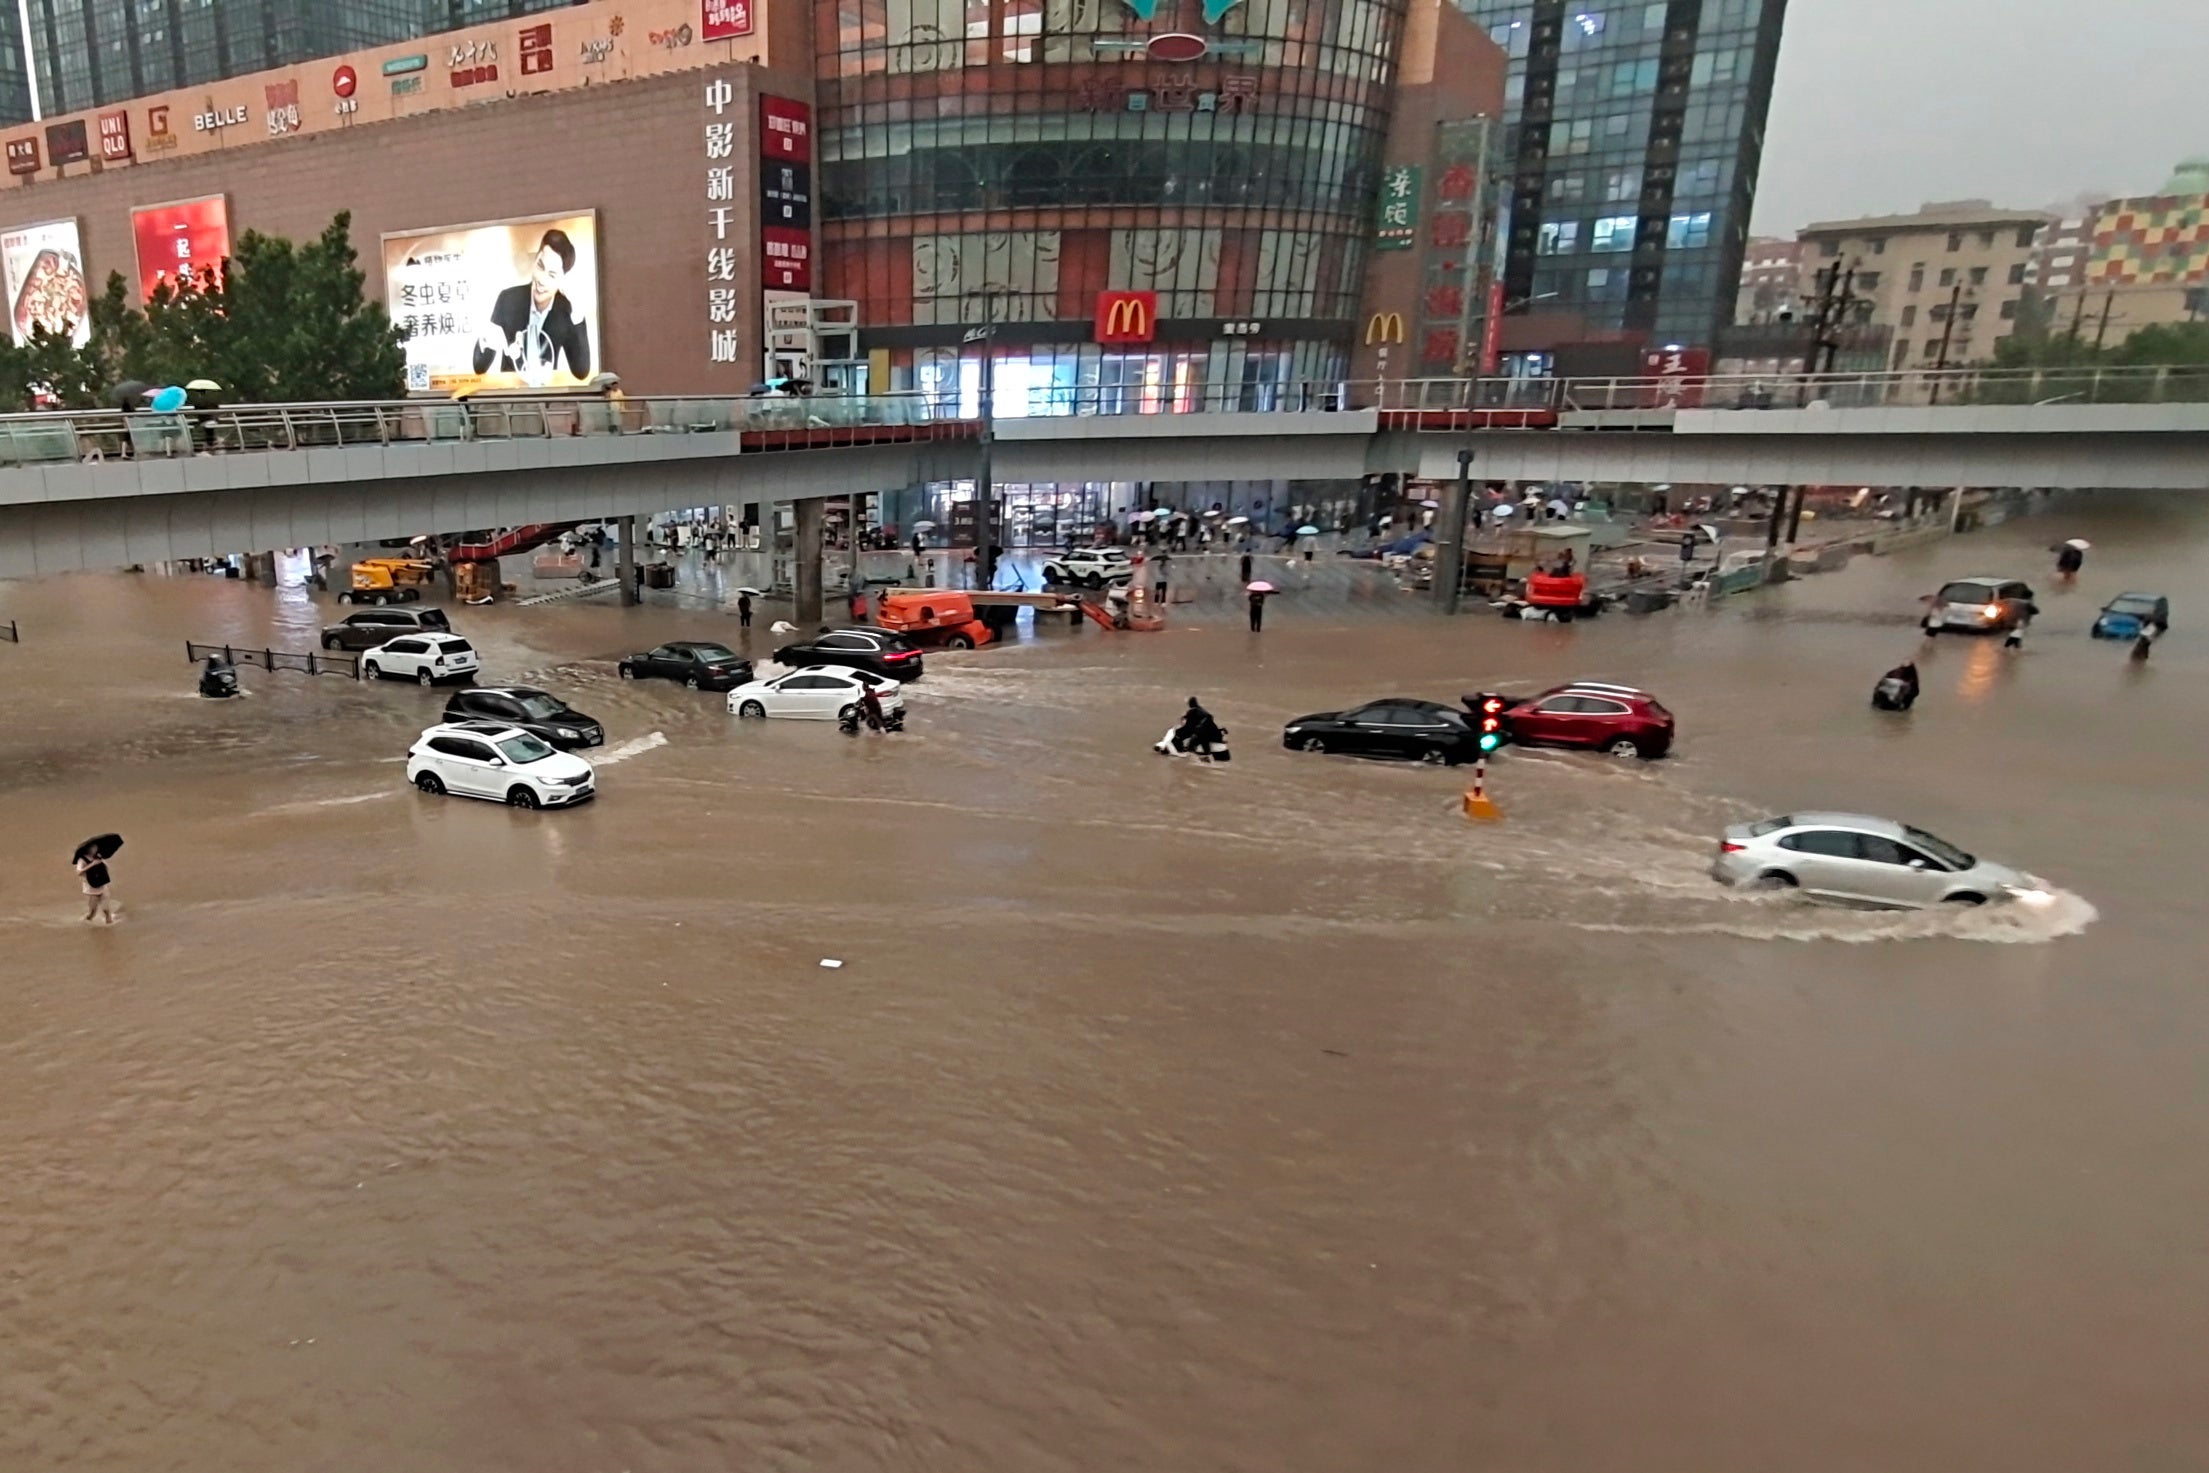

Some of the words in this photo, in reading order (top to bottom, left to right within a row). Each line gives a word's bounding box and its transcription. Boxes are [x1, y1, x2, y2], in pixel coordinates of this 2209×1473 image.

[101, 117, 121, 135] UNI
[194, 105, 248, 131] BELLE
[103, 135, 125, 155] QLO
[705, 79, 738, 363] 中影新干线影城
